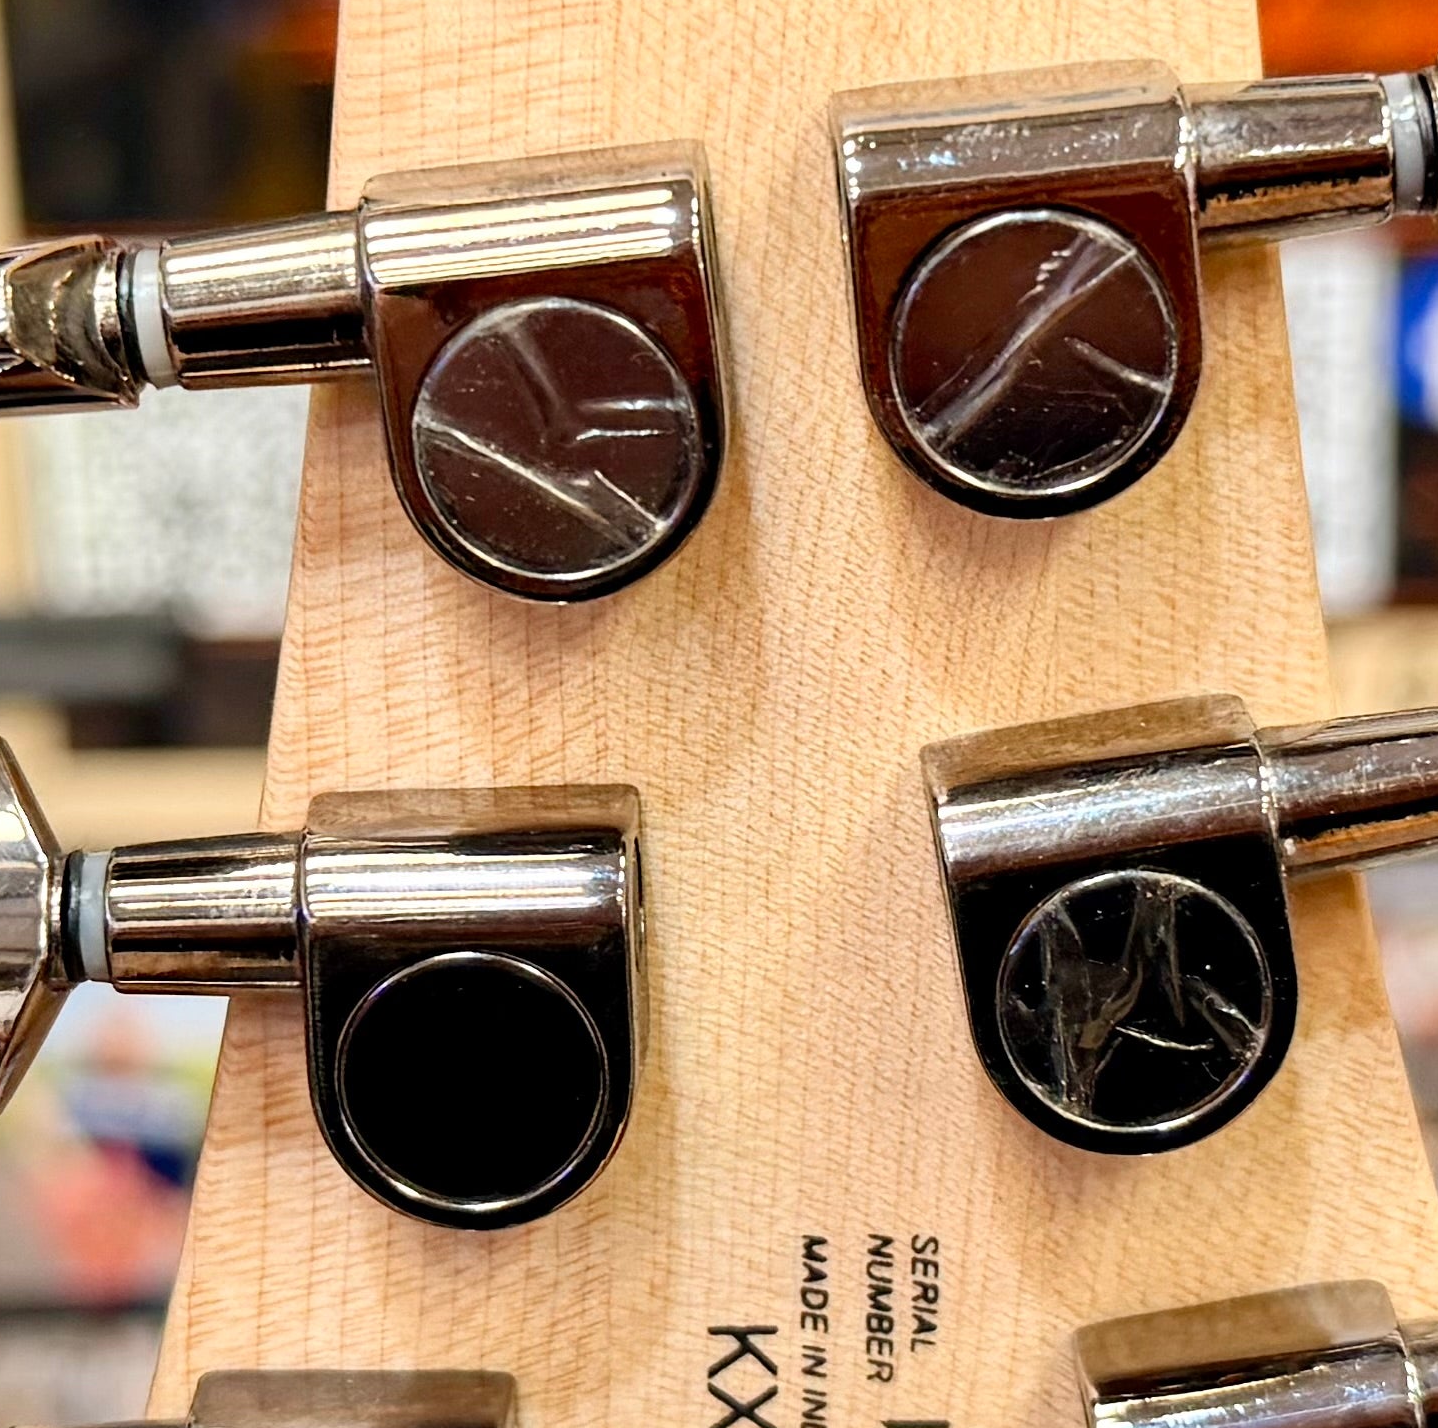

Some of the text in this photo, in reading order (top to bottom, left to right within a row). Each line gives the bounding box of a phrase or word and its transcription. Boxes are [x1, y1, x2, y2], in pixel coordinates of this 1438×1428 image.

[800, 1233, 829, 1335] MADE
[865, 1233, 895, 1384] NUMBER
[909, 1233, 940, 1354] SERIAL
[800, 1344, 828, 1377] IN
